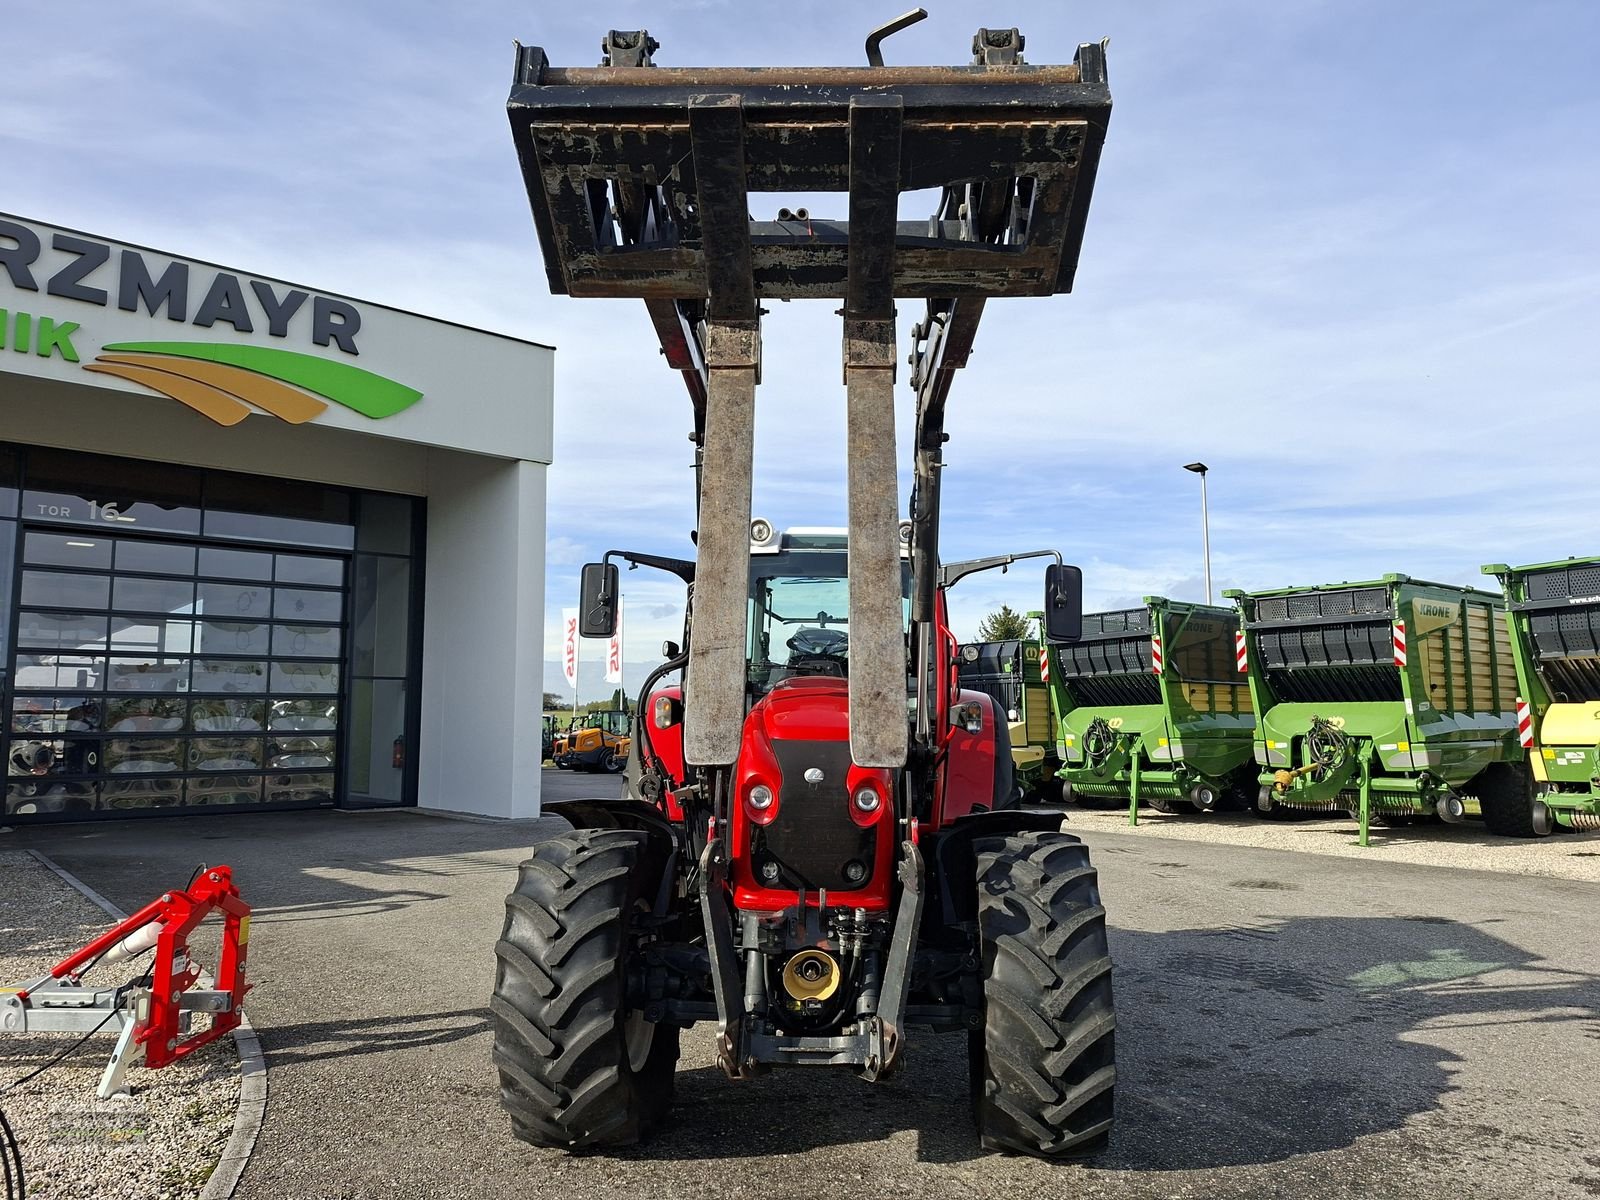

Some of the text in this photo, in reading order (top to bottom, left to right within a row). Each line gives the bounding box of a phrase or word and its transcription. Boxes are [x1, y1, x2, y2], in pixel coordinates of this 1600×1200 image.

[0, 220, 361, 355] RZMAYR
[0, 308, 81, 363] IK
[37, 500, 120, 522] TOR 16
[1419, 603, 1451, 619] KRONE
